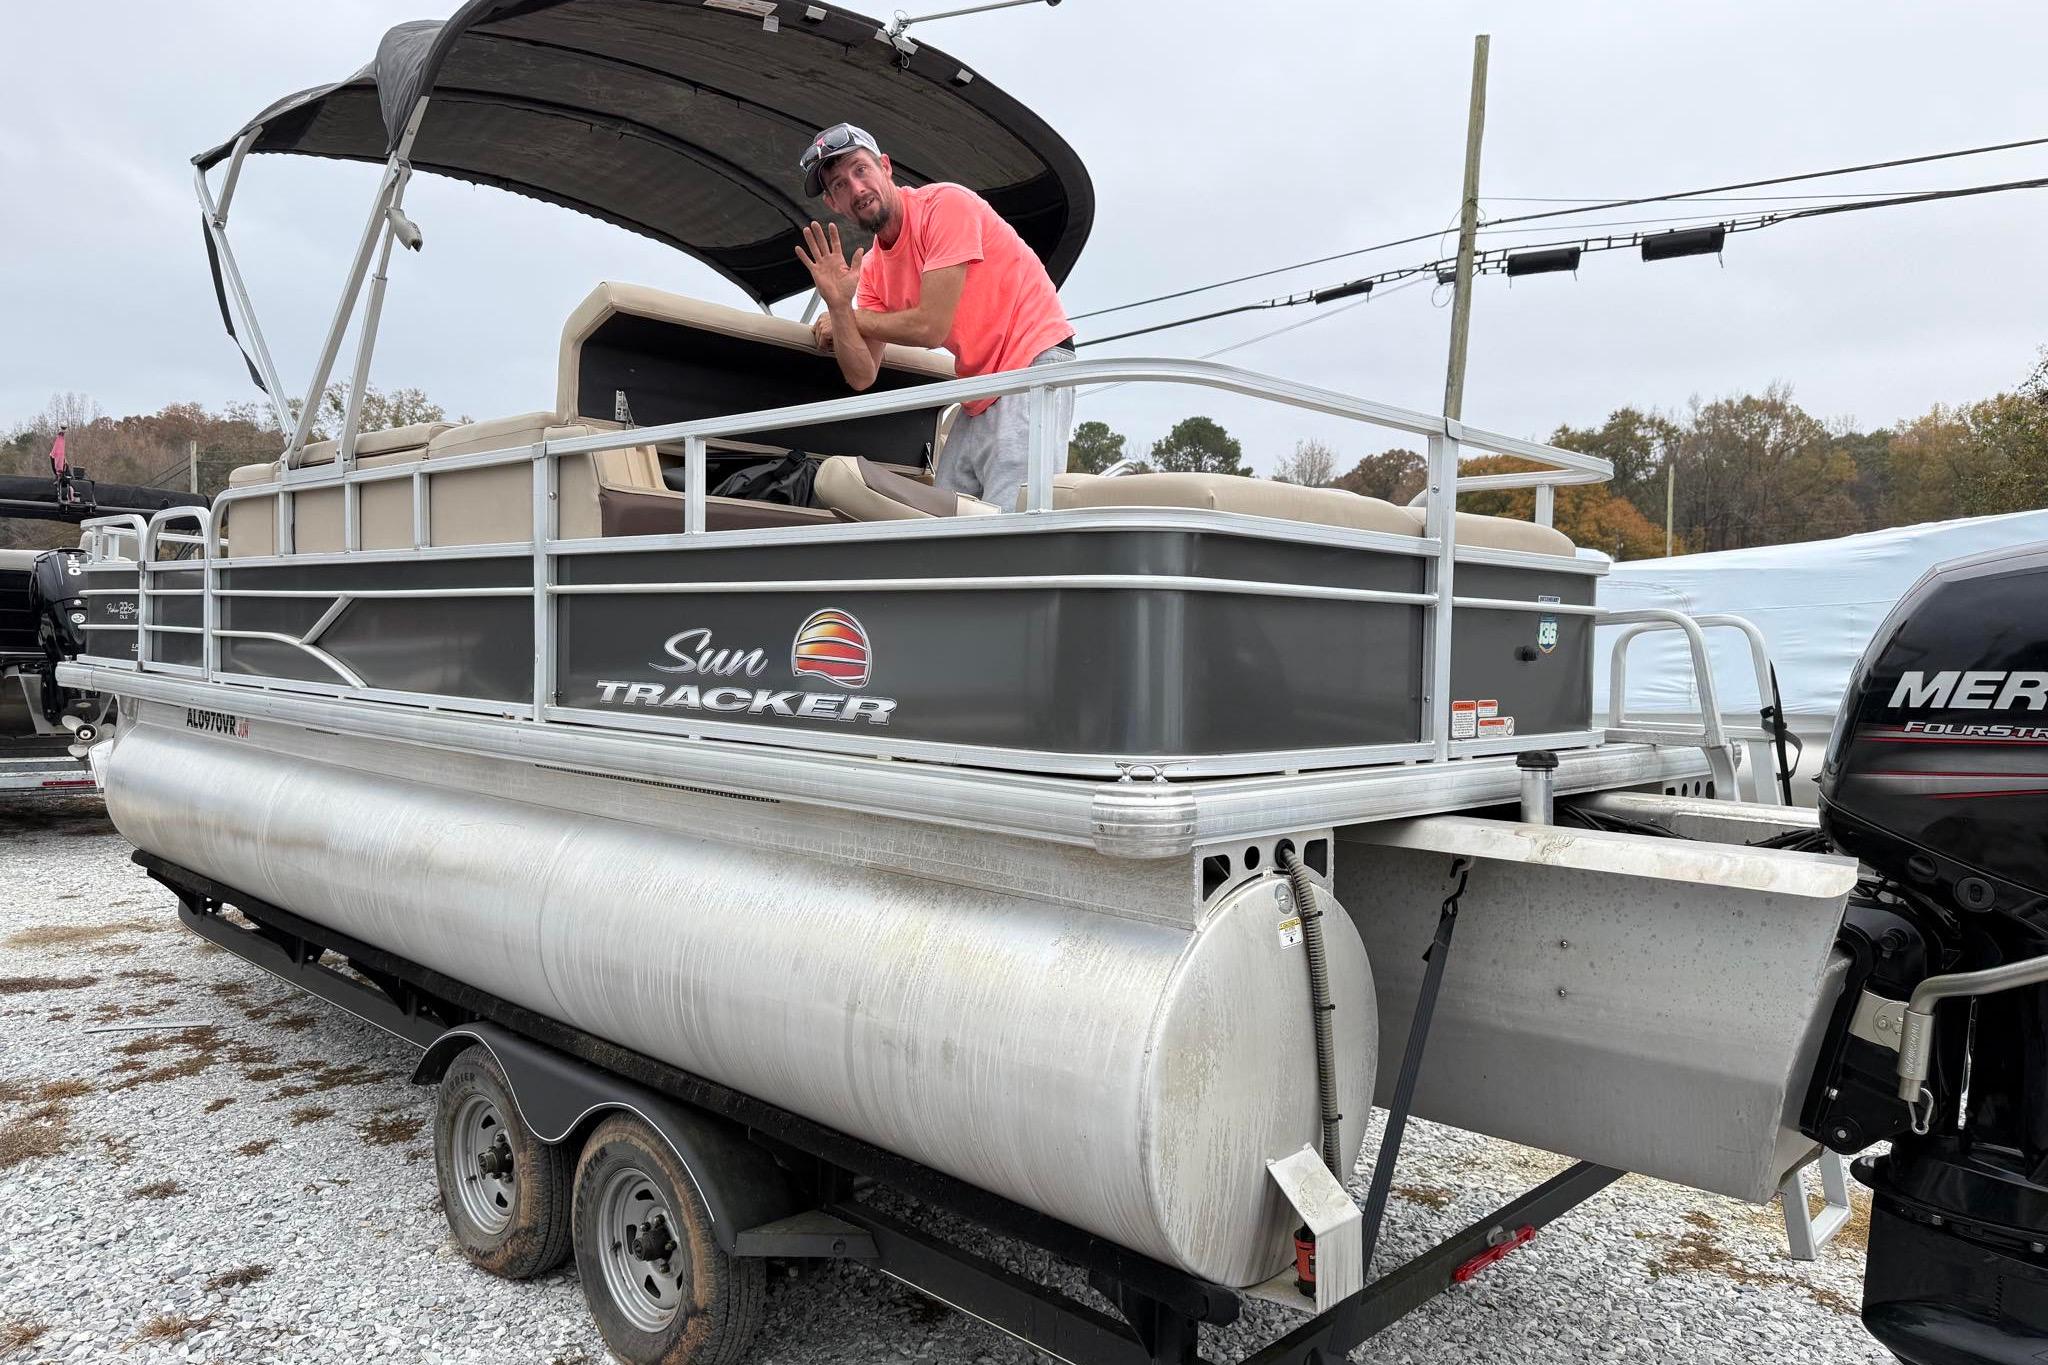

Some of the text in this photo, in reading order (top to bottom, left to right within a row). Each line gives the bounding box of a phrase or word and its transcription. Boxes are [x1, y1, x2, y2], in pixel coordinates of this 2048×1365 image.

[649, 628, 769, 677] Sun
[596, 680, 898, 726] TRACKER
[1887, 671, 2048, 710] MER
[186, 707, 237, 736] AL0970VR
